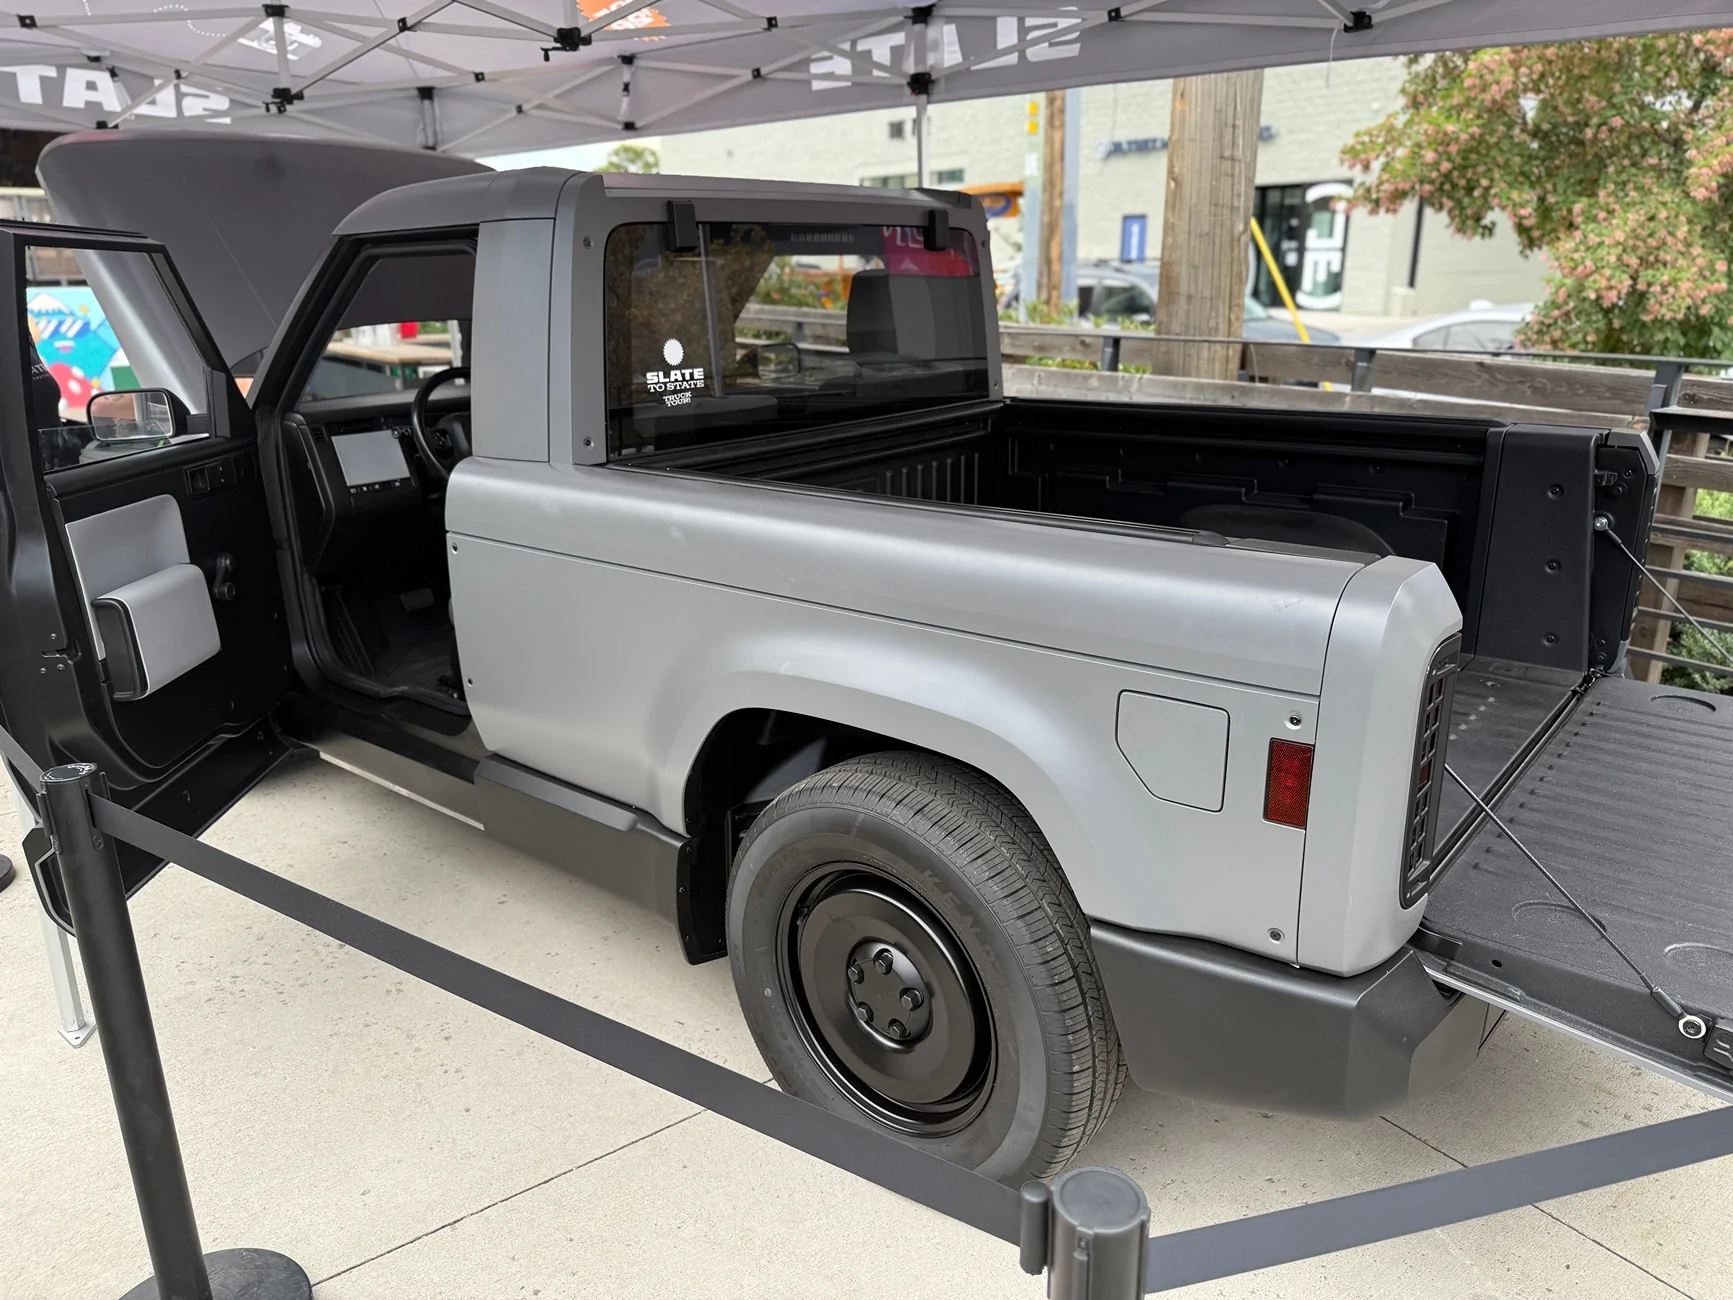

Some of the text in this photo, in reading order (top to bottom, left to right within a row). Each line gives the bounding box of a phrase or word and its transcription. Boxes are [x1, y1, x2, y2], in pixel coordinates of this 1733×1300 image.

[646, 367, 704, 384] SLATE
[647, 379, 705, 393] TO STATE
[662, 391, 692, 402] TRUCK
[665, 397, 691, 407] TOUR!
